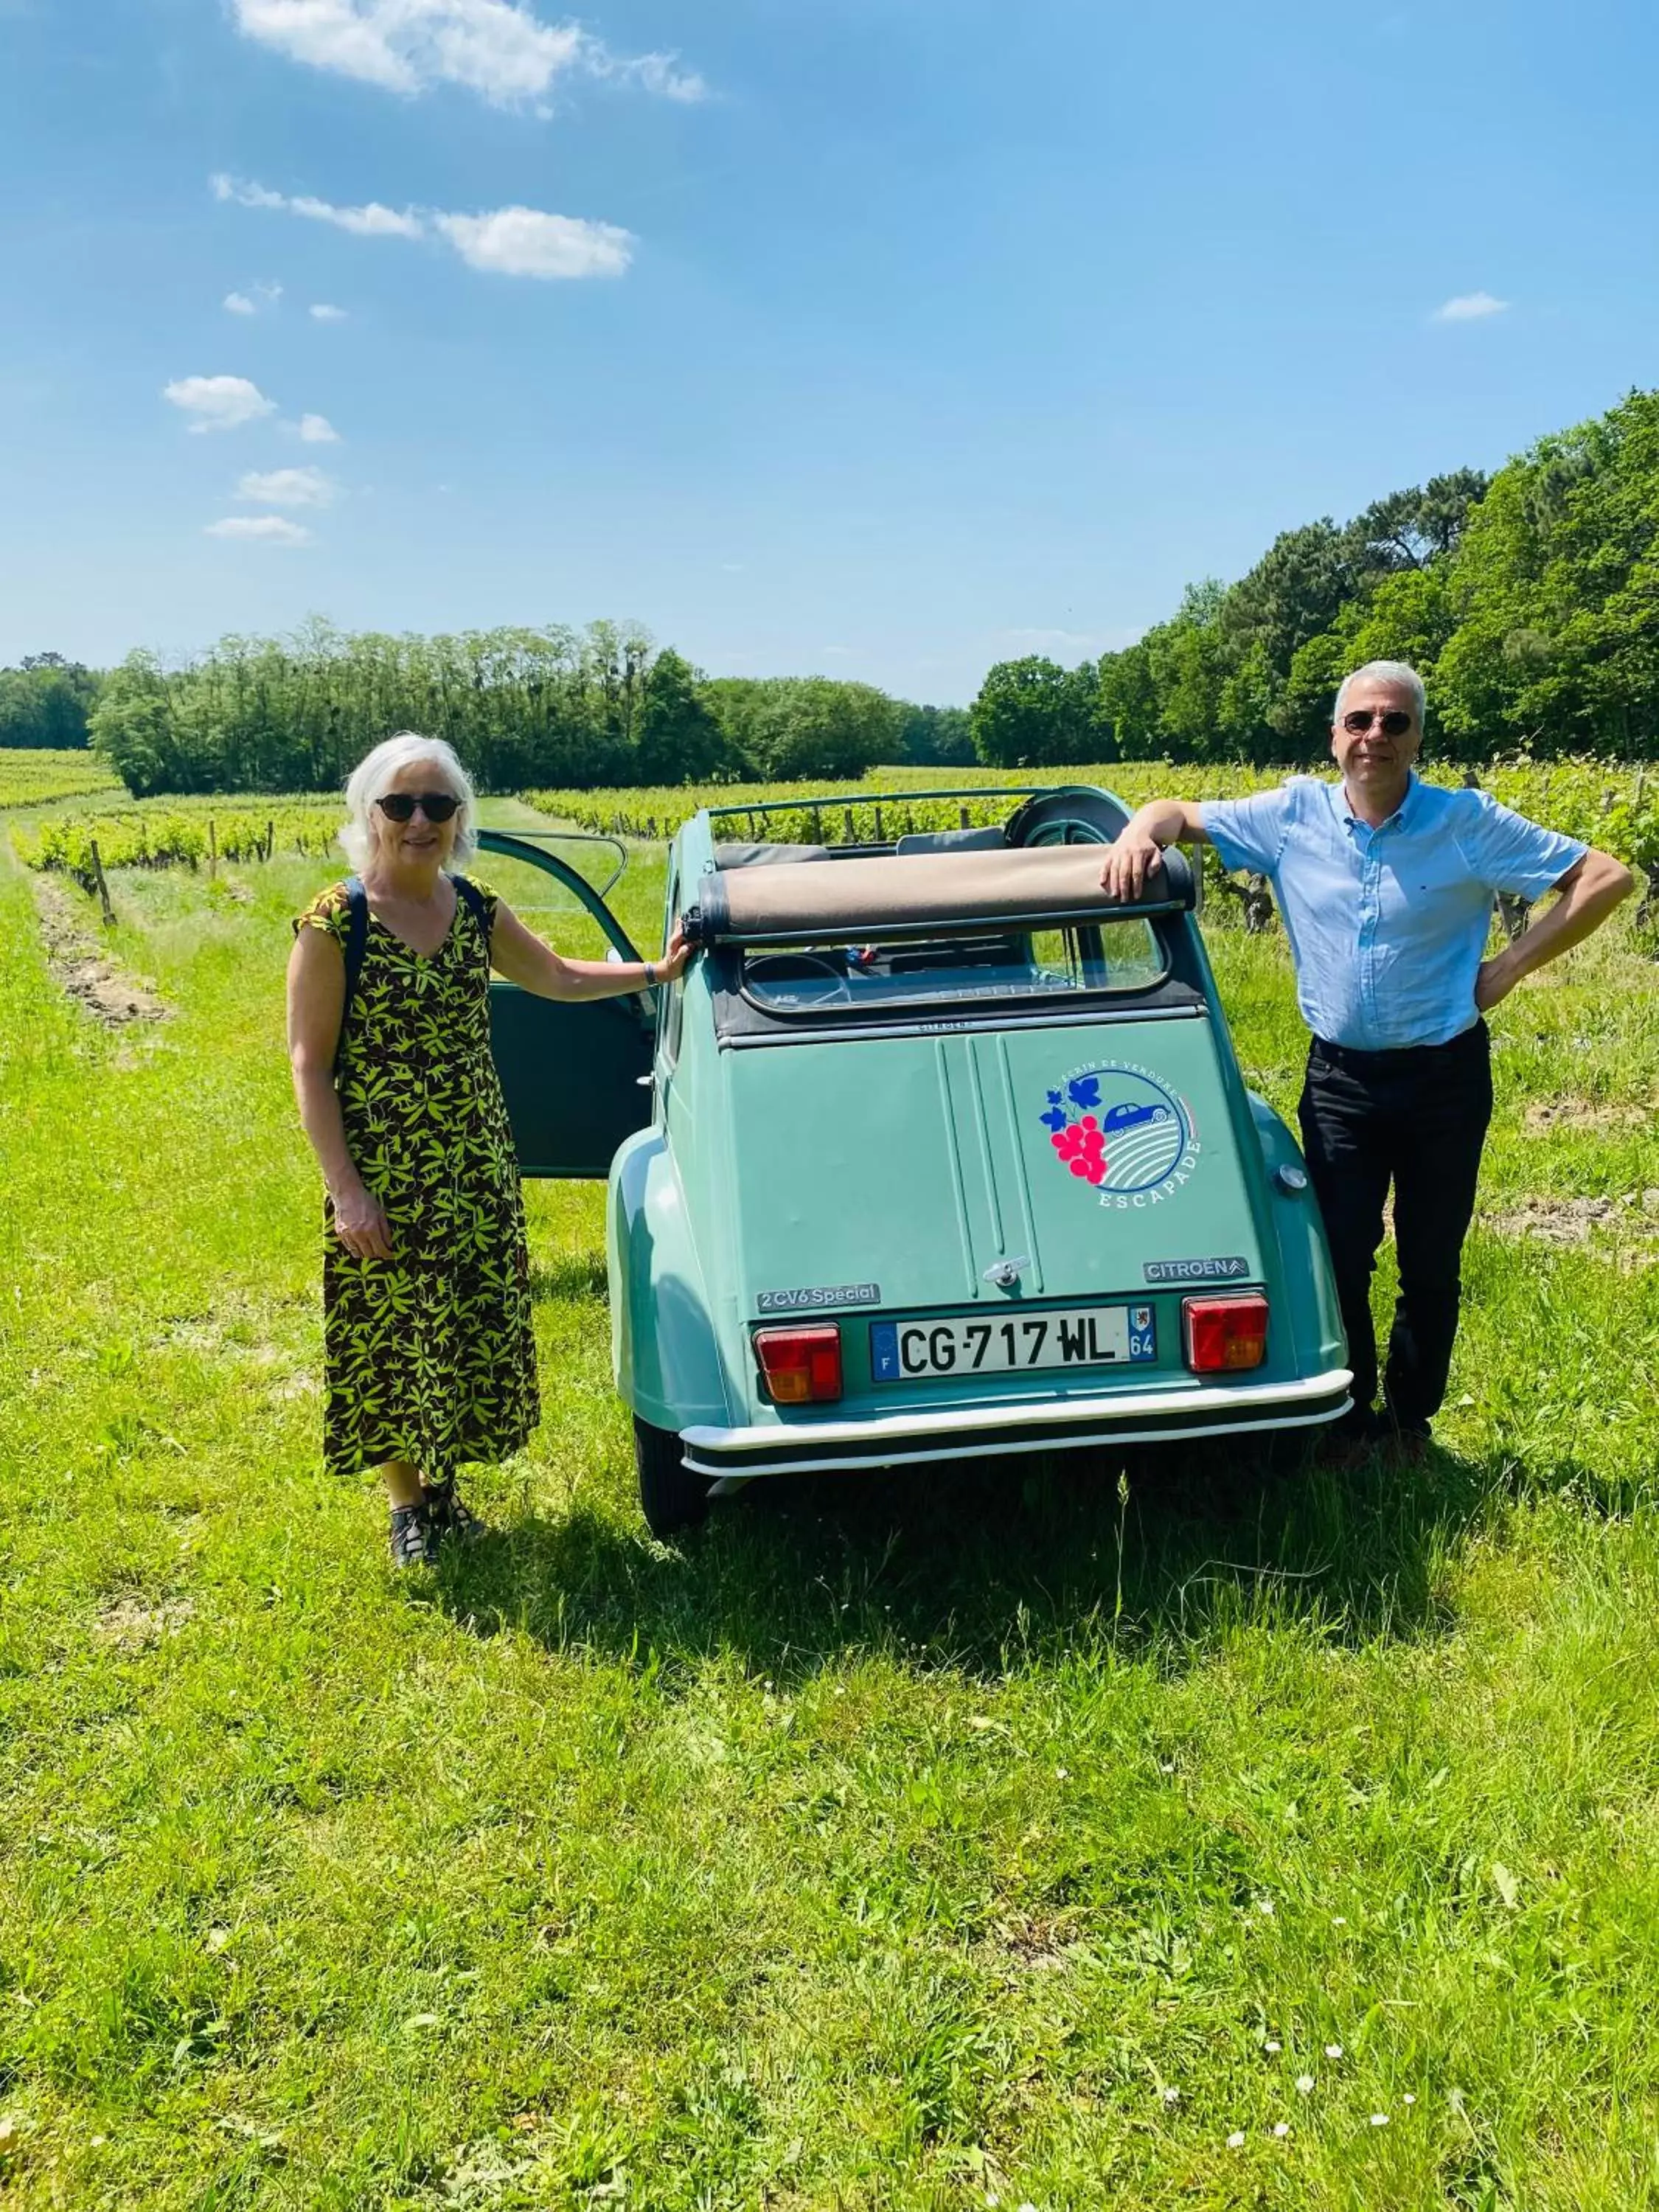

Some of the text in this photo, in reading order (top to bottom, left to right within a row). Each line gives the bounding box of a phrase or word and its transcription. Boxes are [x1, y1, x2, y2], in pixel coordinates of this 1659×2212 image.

[1098, 1141, 1201, 1208] ESCAPADE
[1130, 1334, 1153, 1355] 64
[881, 1357, 891, 1370] F
